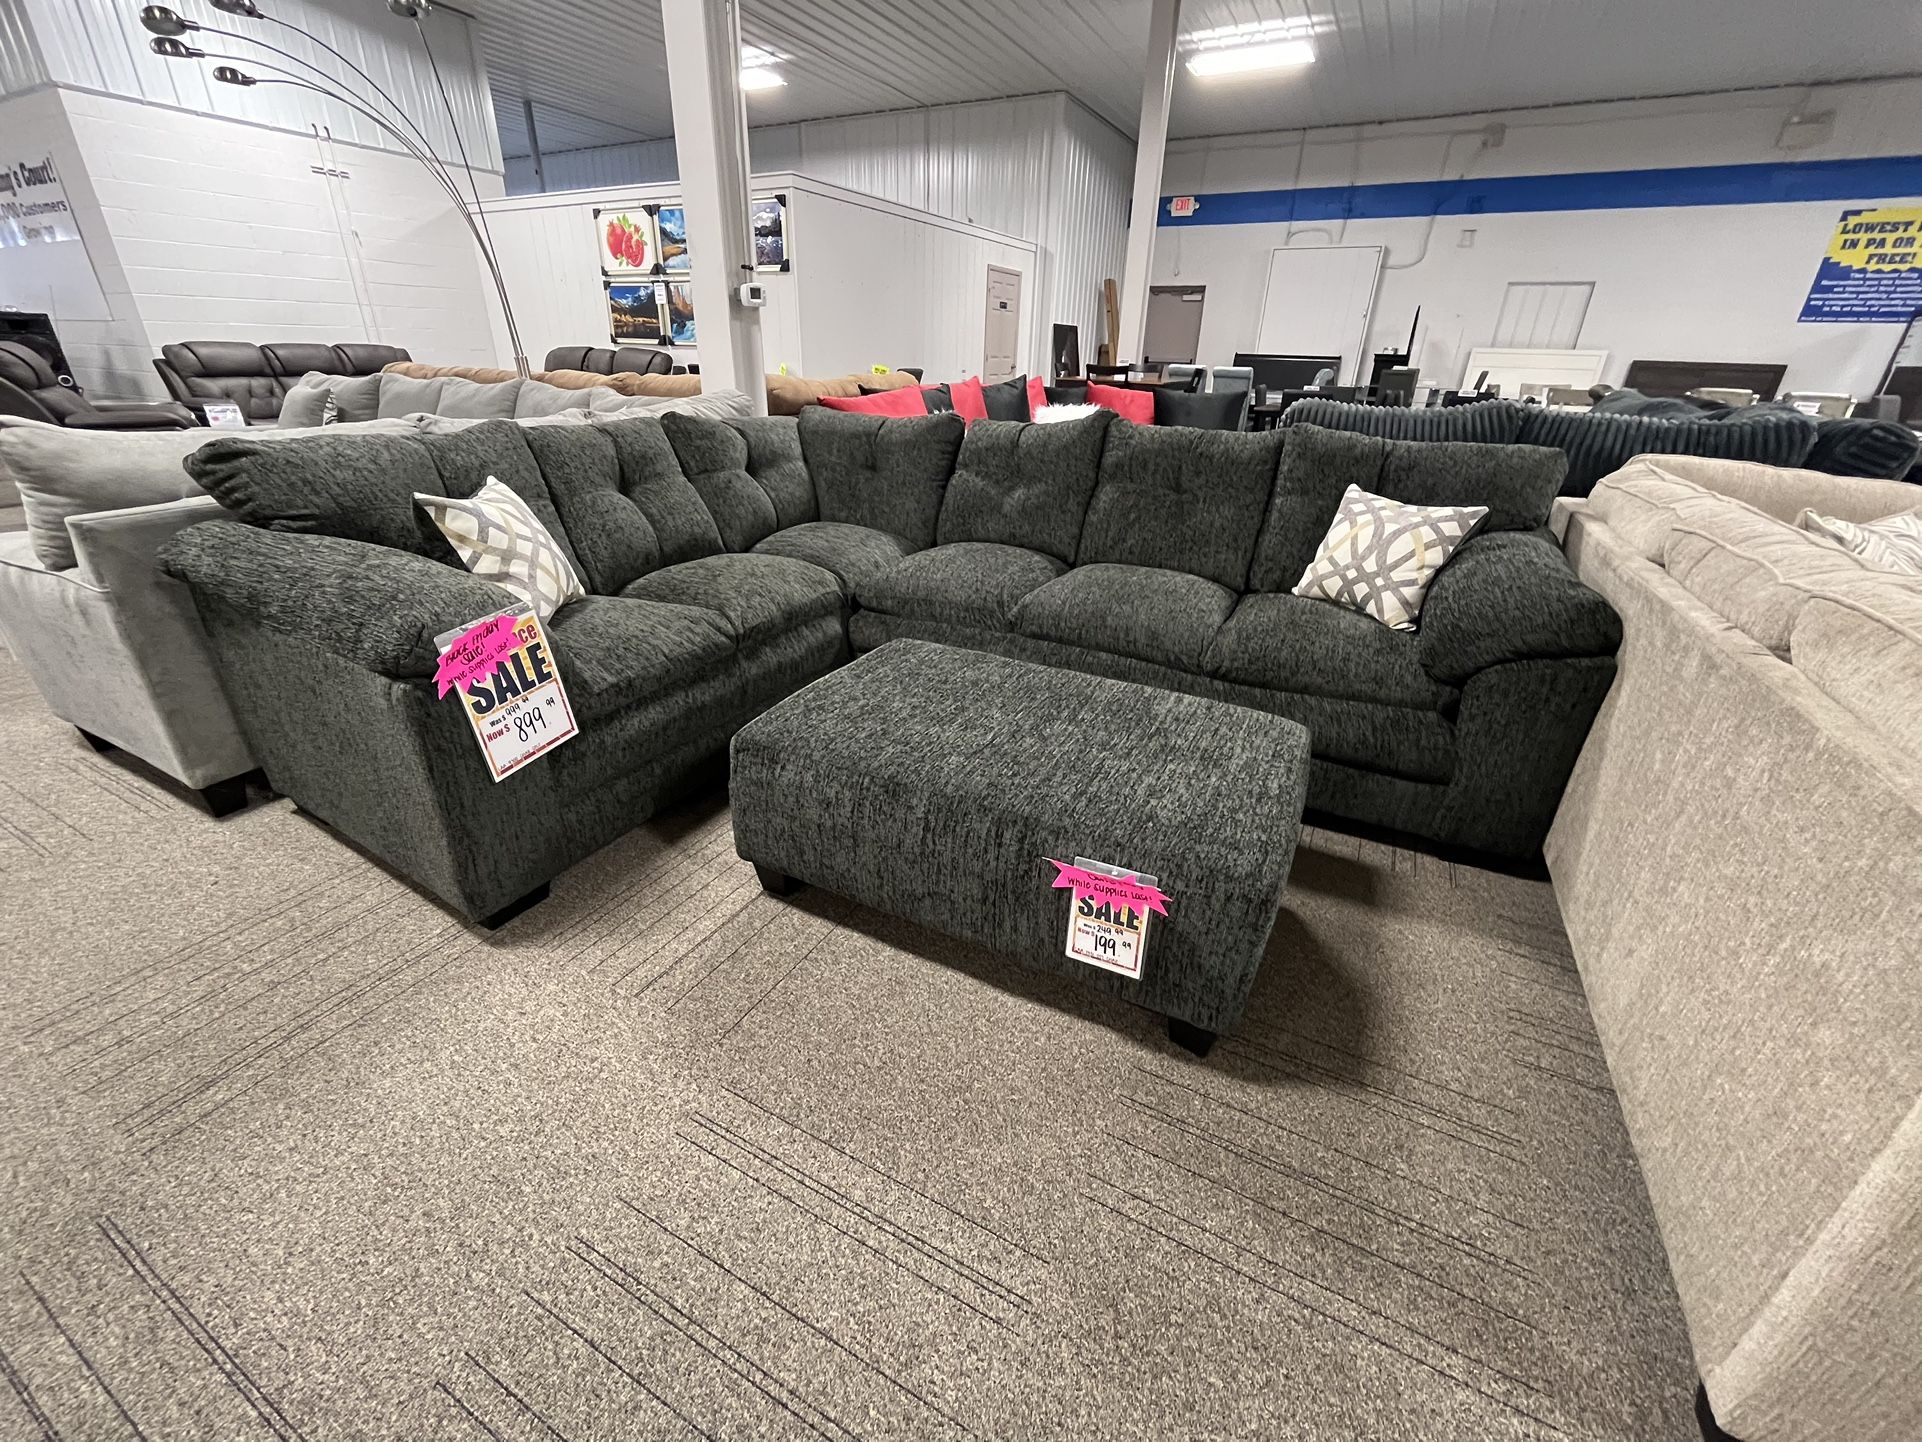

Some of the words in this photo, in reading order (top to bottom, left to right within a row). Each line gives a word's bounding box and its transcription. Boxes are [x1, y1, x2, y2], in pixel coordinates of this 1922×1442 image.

[1176, 198, 1191, 210] EXIT
[1840, 220, 1915, 234] LOWEST
[1840, 238, 1861, 250] IN
[1864, 238, 1887, 249] PA
[1892, 236, 1916, 248] OR
[1865, 252, 1917, 264] FREE!
[467, 642, 552, 715] SALE
[514, 706, 547, 742] 899
[1078, 894, 1140, 930] SALE
[1094, 934, 1116, 956] 199
[1122, 940, 1132, 950] 99
